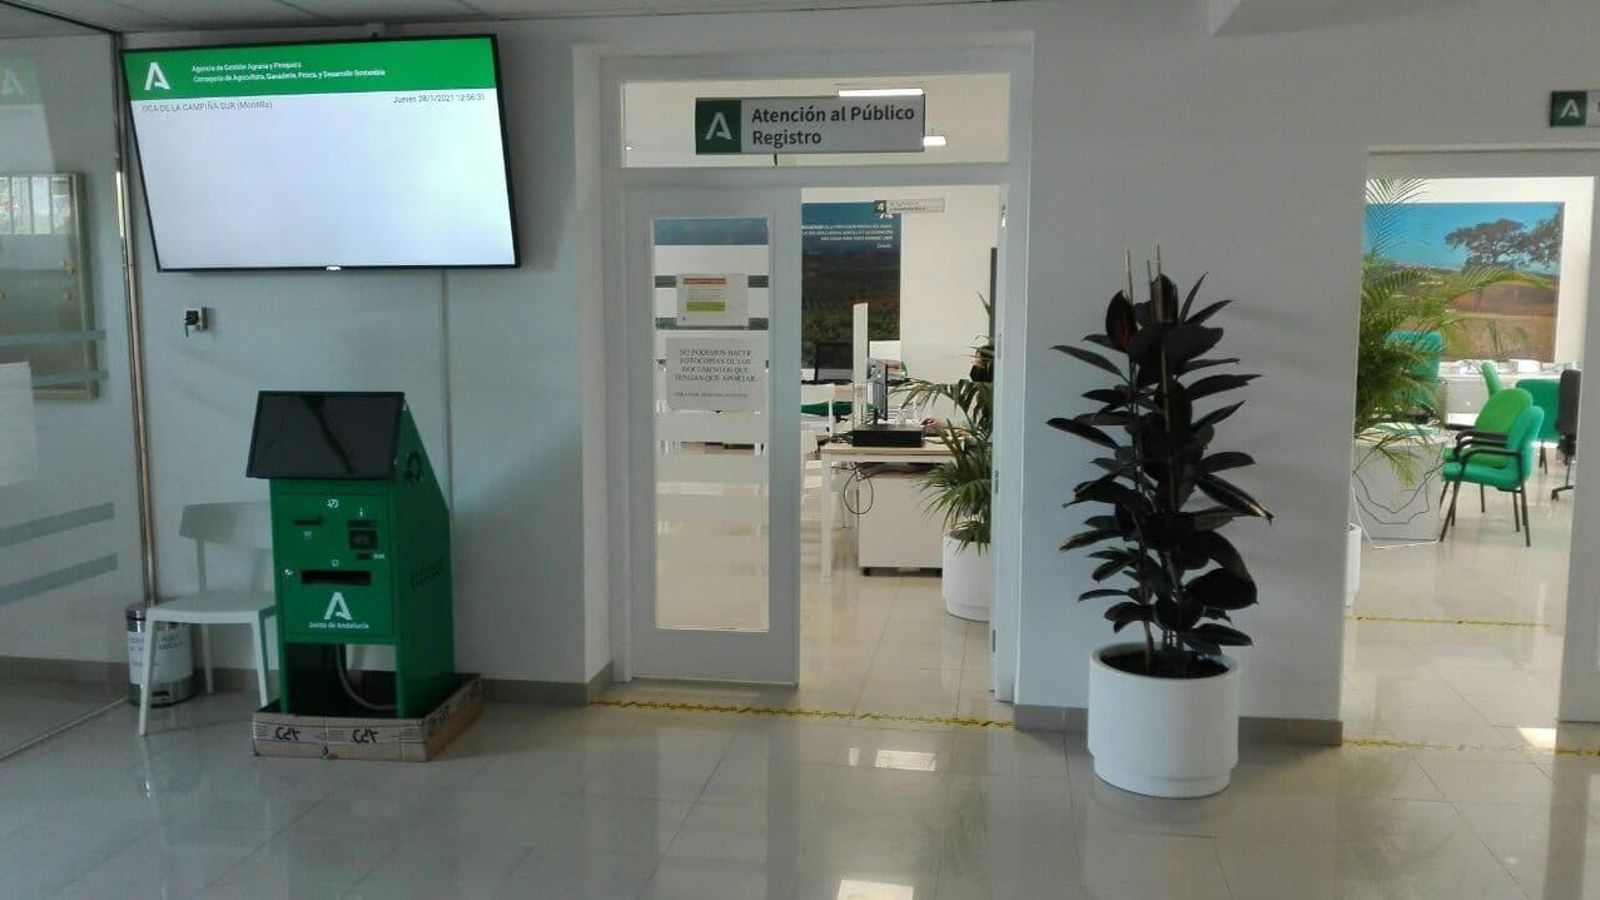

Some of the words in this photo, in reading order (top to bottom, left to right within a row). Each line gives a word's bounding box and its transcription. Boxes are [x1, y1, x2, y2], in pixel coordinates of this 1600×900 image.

[172, 103, 181, 111] LA
[751, 105, 826, 123] Atención
[831, 106, 845, 122] al
[851, 103, 915, 121] Público
[752, 130, 822, 149] Registro
